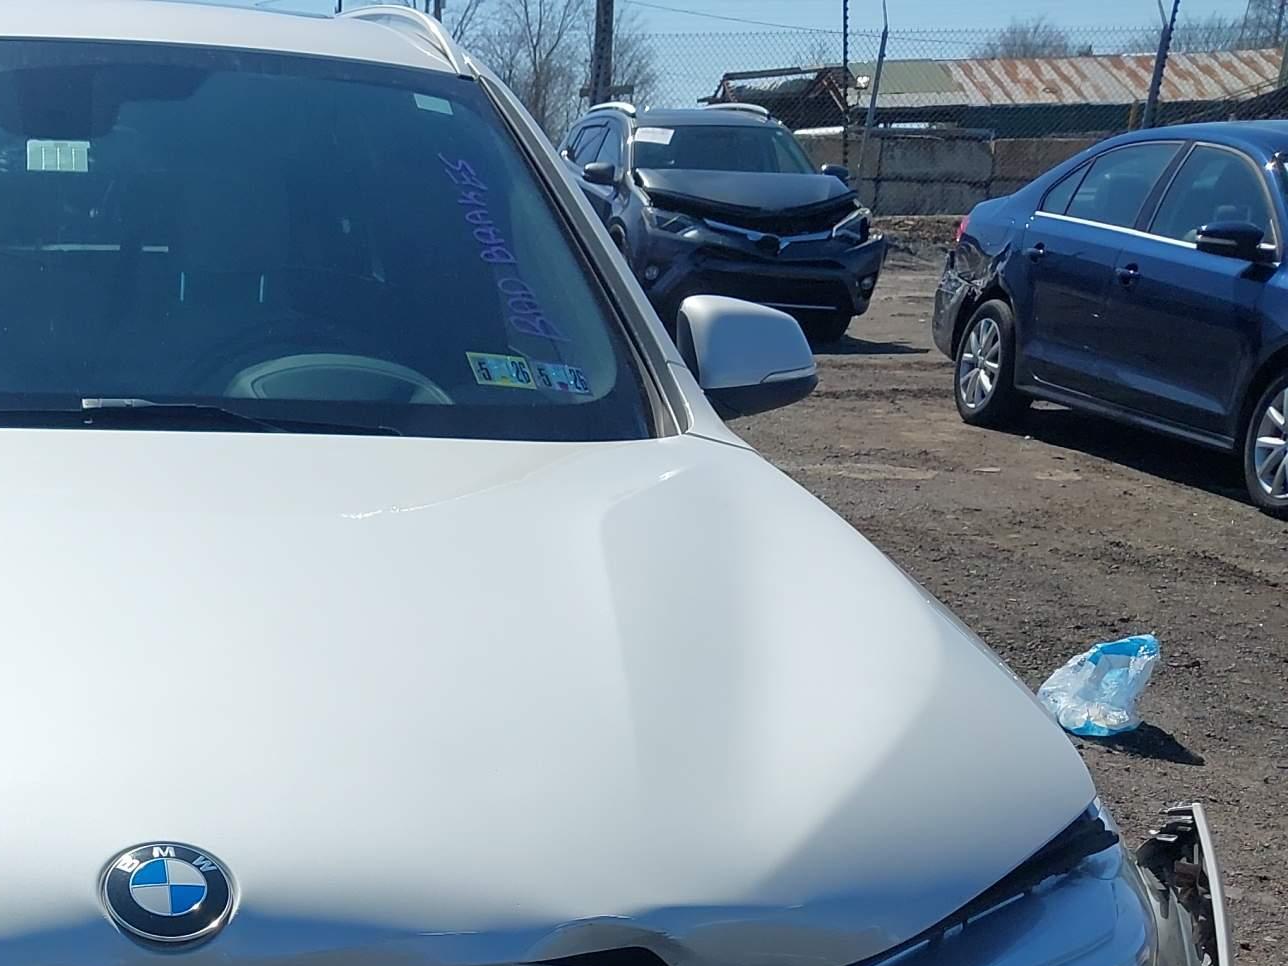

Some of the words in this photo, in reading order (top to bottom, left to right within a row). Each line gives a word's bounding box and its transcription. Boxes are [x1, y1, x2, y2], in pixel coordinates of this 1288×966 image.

[497, 277, 574, 343] BAD
[511, 360, 532, 384] 26
[115, 846, 217, 873] BMW
